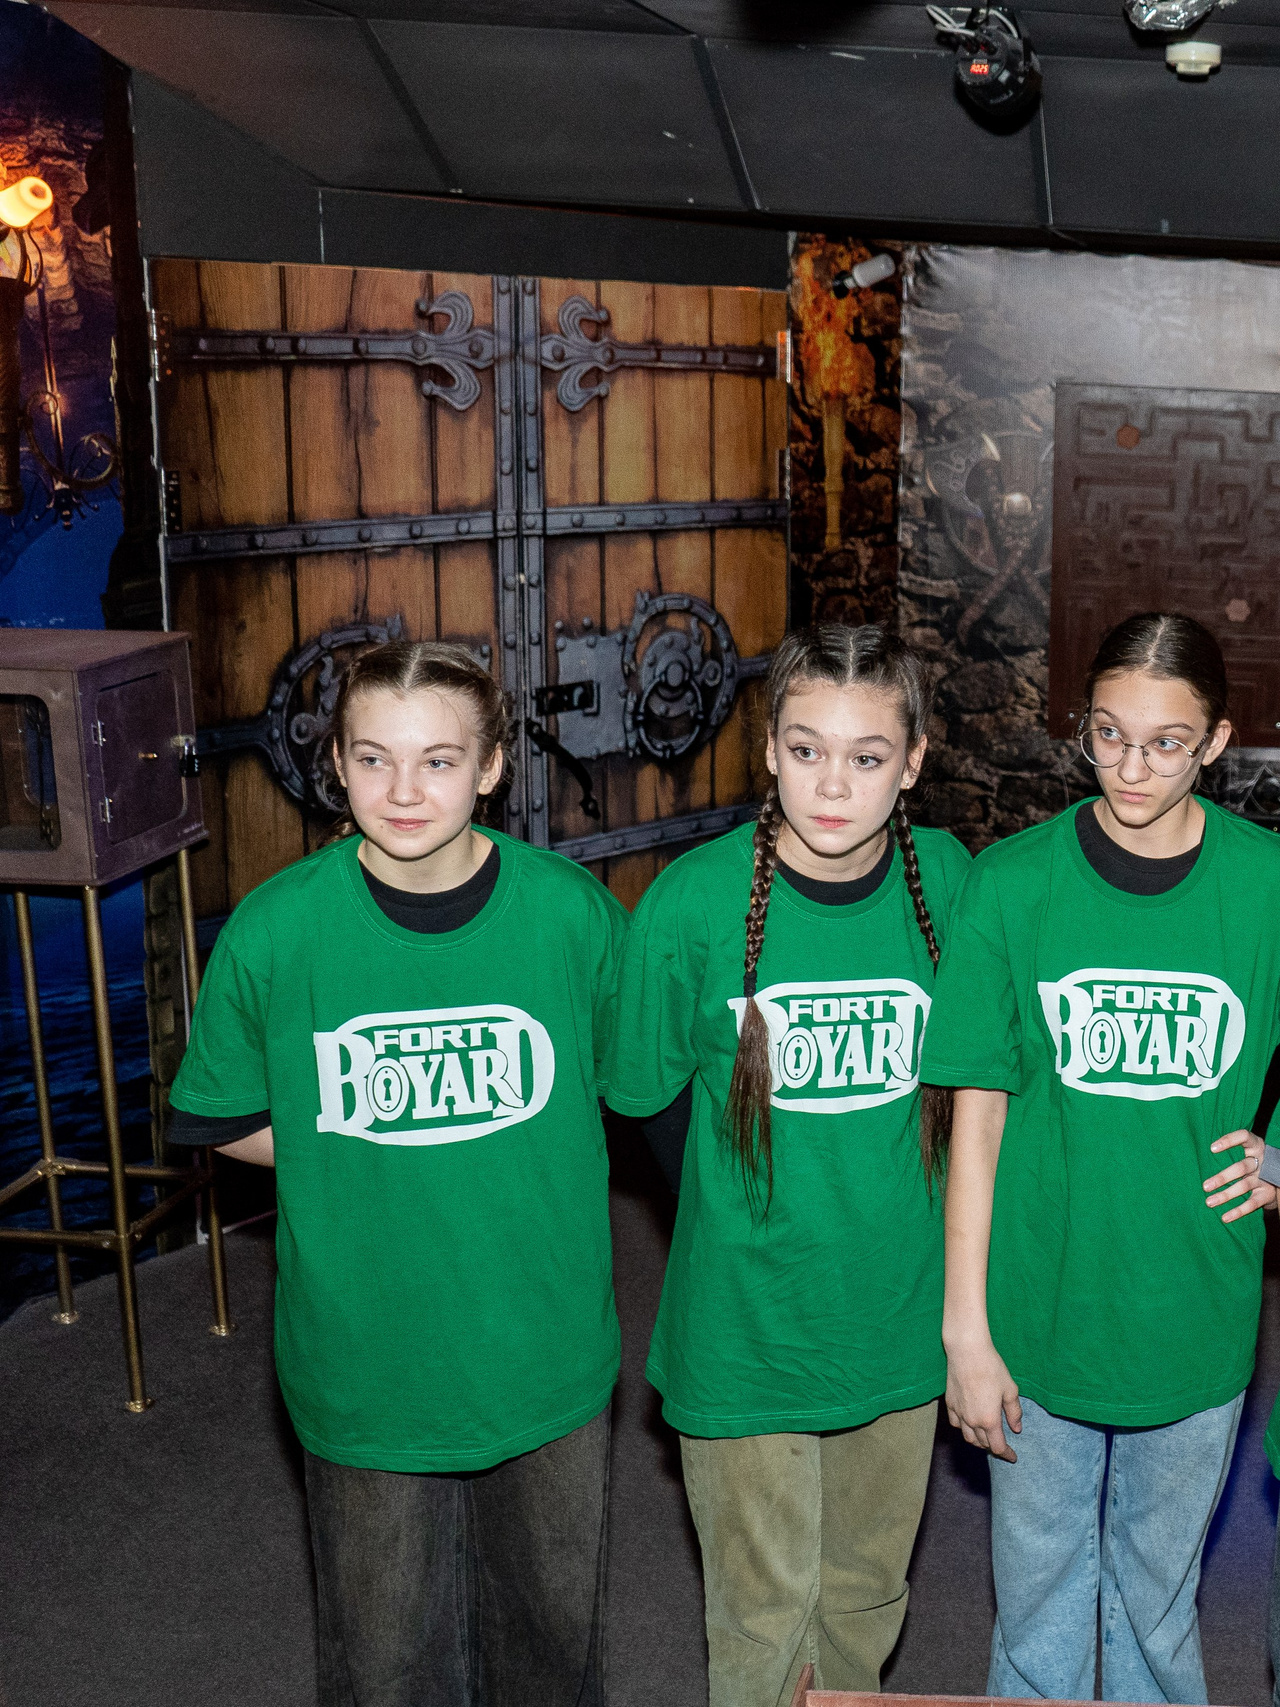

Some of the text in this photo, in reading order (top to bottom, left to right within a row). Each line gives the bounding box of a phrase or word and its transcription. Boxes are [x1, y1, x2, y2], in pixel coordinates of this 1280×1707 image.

[789, 995, 890, 1023] FORT
[1092, 984, 1196, 1012] FORT
[374, 1022, 489, 1054] FORT
[1037, 981, 1246, 1086] BOYARD
[313, 1018, 555, 1134] BOYARD
